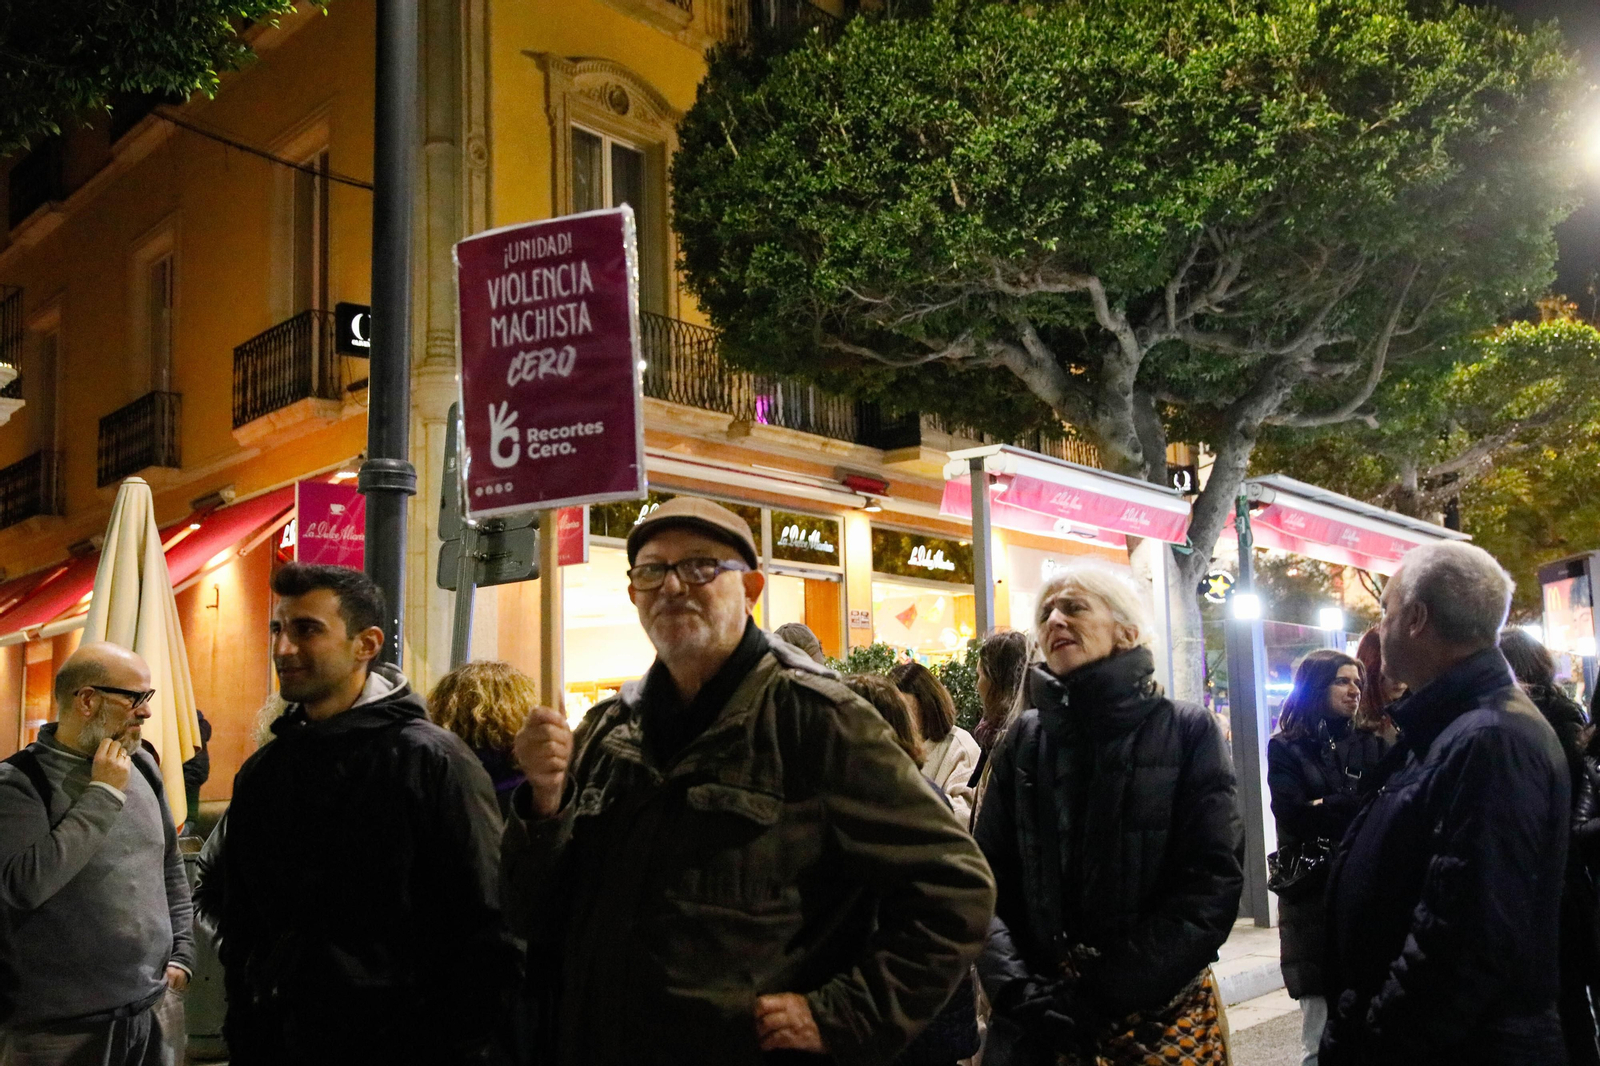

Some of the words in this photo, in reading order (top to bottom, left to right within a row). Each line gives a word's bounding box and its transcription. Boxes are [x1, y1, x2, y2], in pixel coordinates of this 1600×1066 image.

[504, 232, 573, 269] ¡UNIDAD!
[487, 259, 595, 310] VIOLENCIA
[490, 300, 593, 348] MACHISTA
[507, 345, 577, 387] CERO
[527, 421, 604, 442] Recortes
[527, 441, 577, 459] Cero.
[302, 522, 315, 538] La
[315, 520, 340, 541] Dulce
